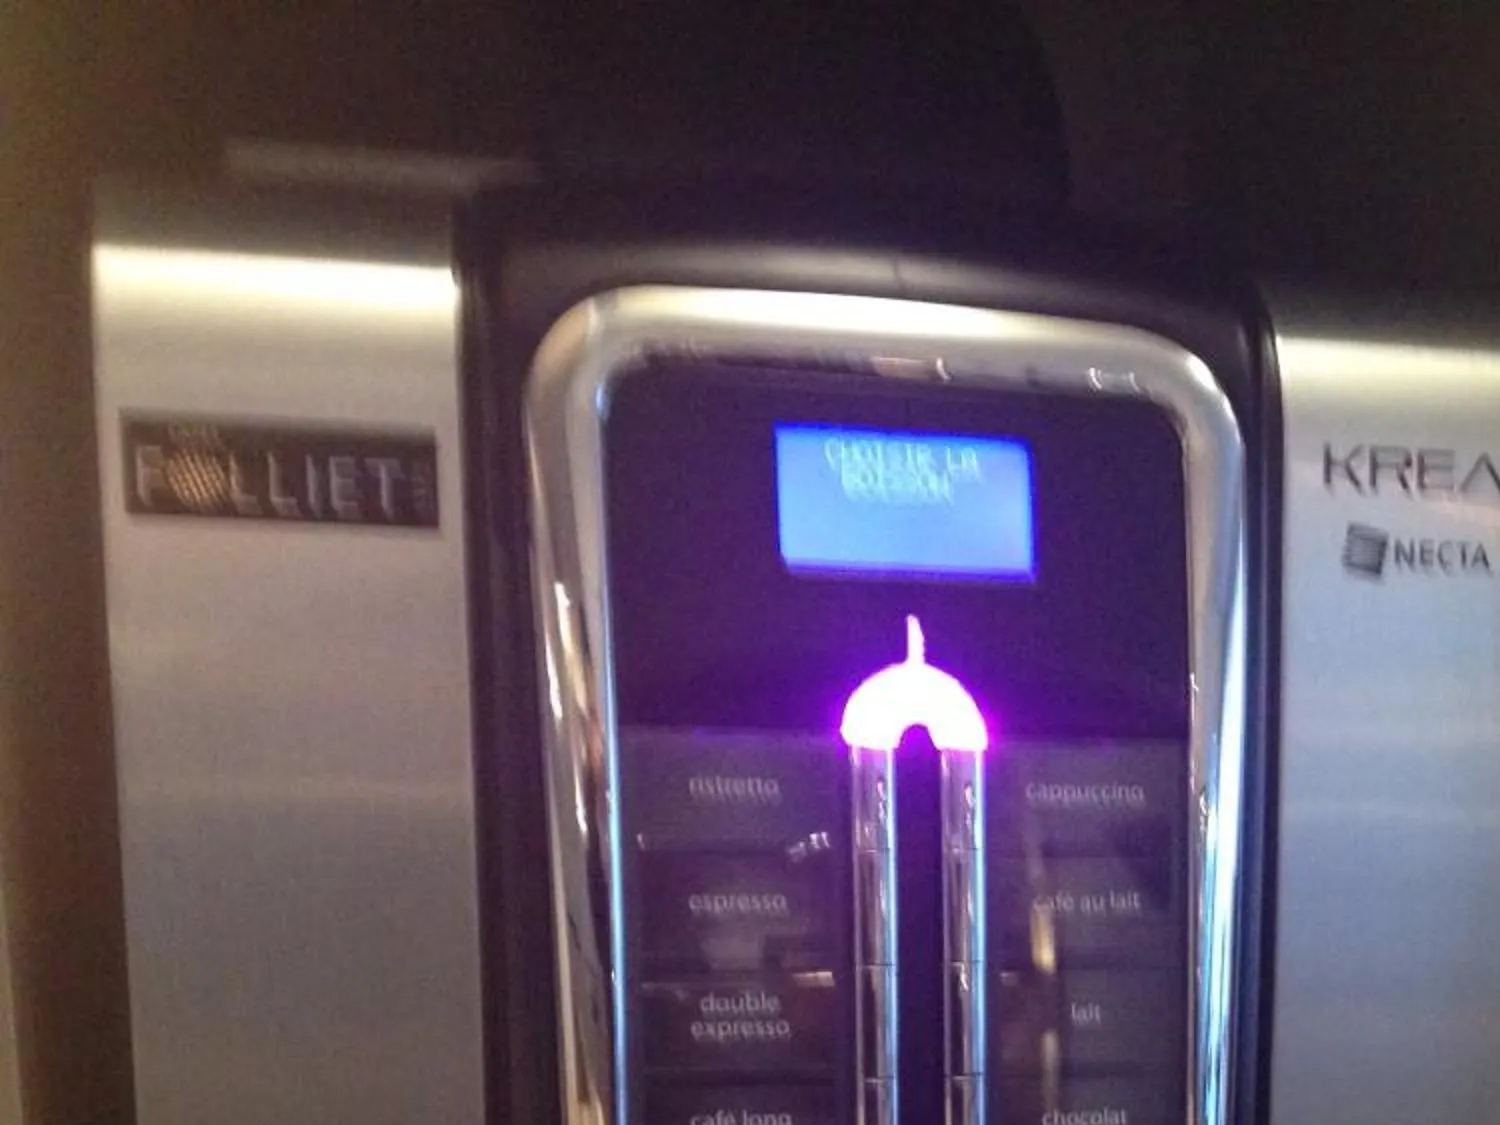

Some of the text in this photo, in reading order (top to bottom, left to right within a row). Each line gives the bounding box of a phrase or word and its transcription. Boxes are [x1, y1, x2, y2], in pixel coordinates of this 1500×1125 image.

[1394, 538, 1492, 575] NECTA
[1025, 782, 1145, 807] cappuccino
[700, 993, 781, 1016] double
[1071, 1003, 1102, 1025] lait
[690, 1019, 790, 1041] expresso
